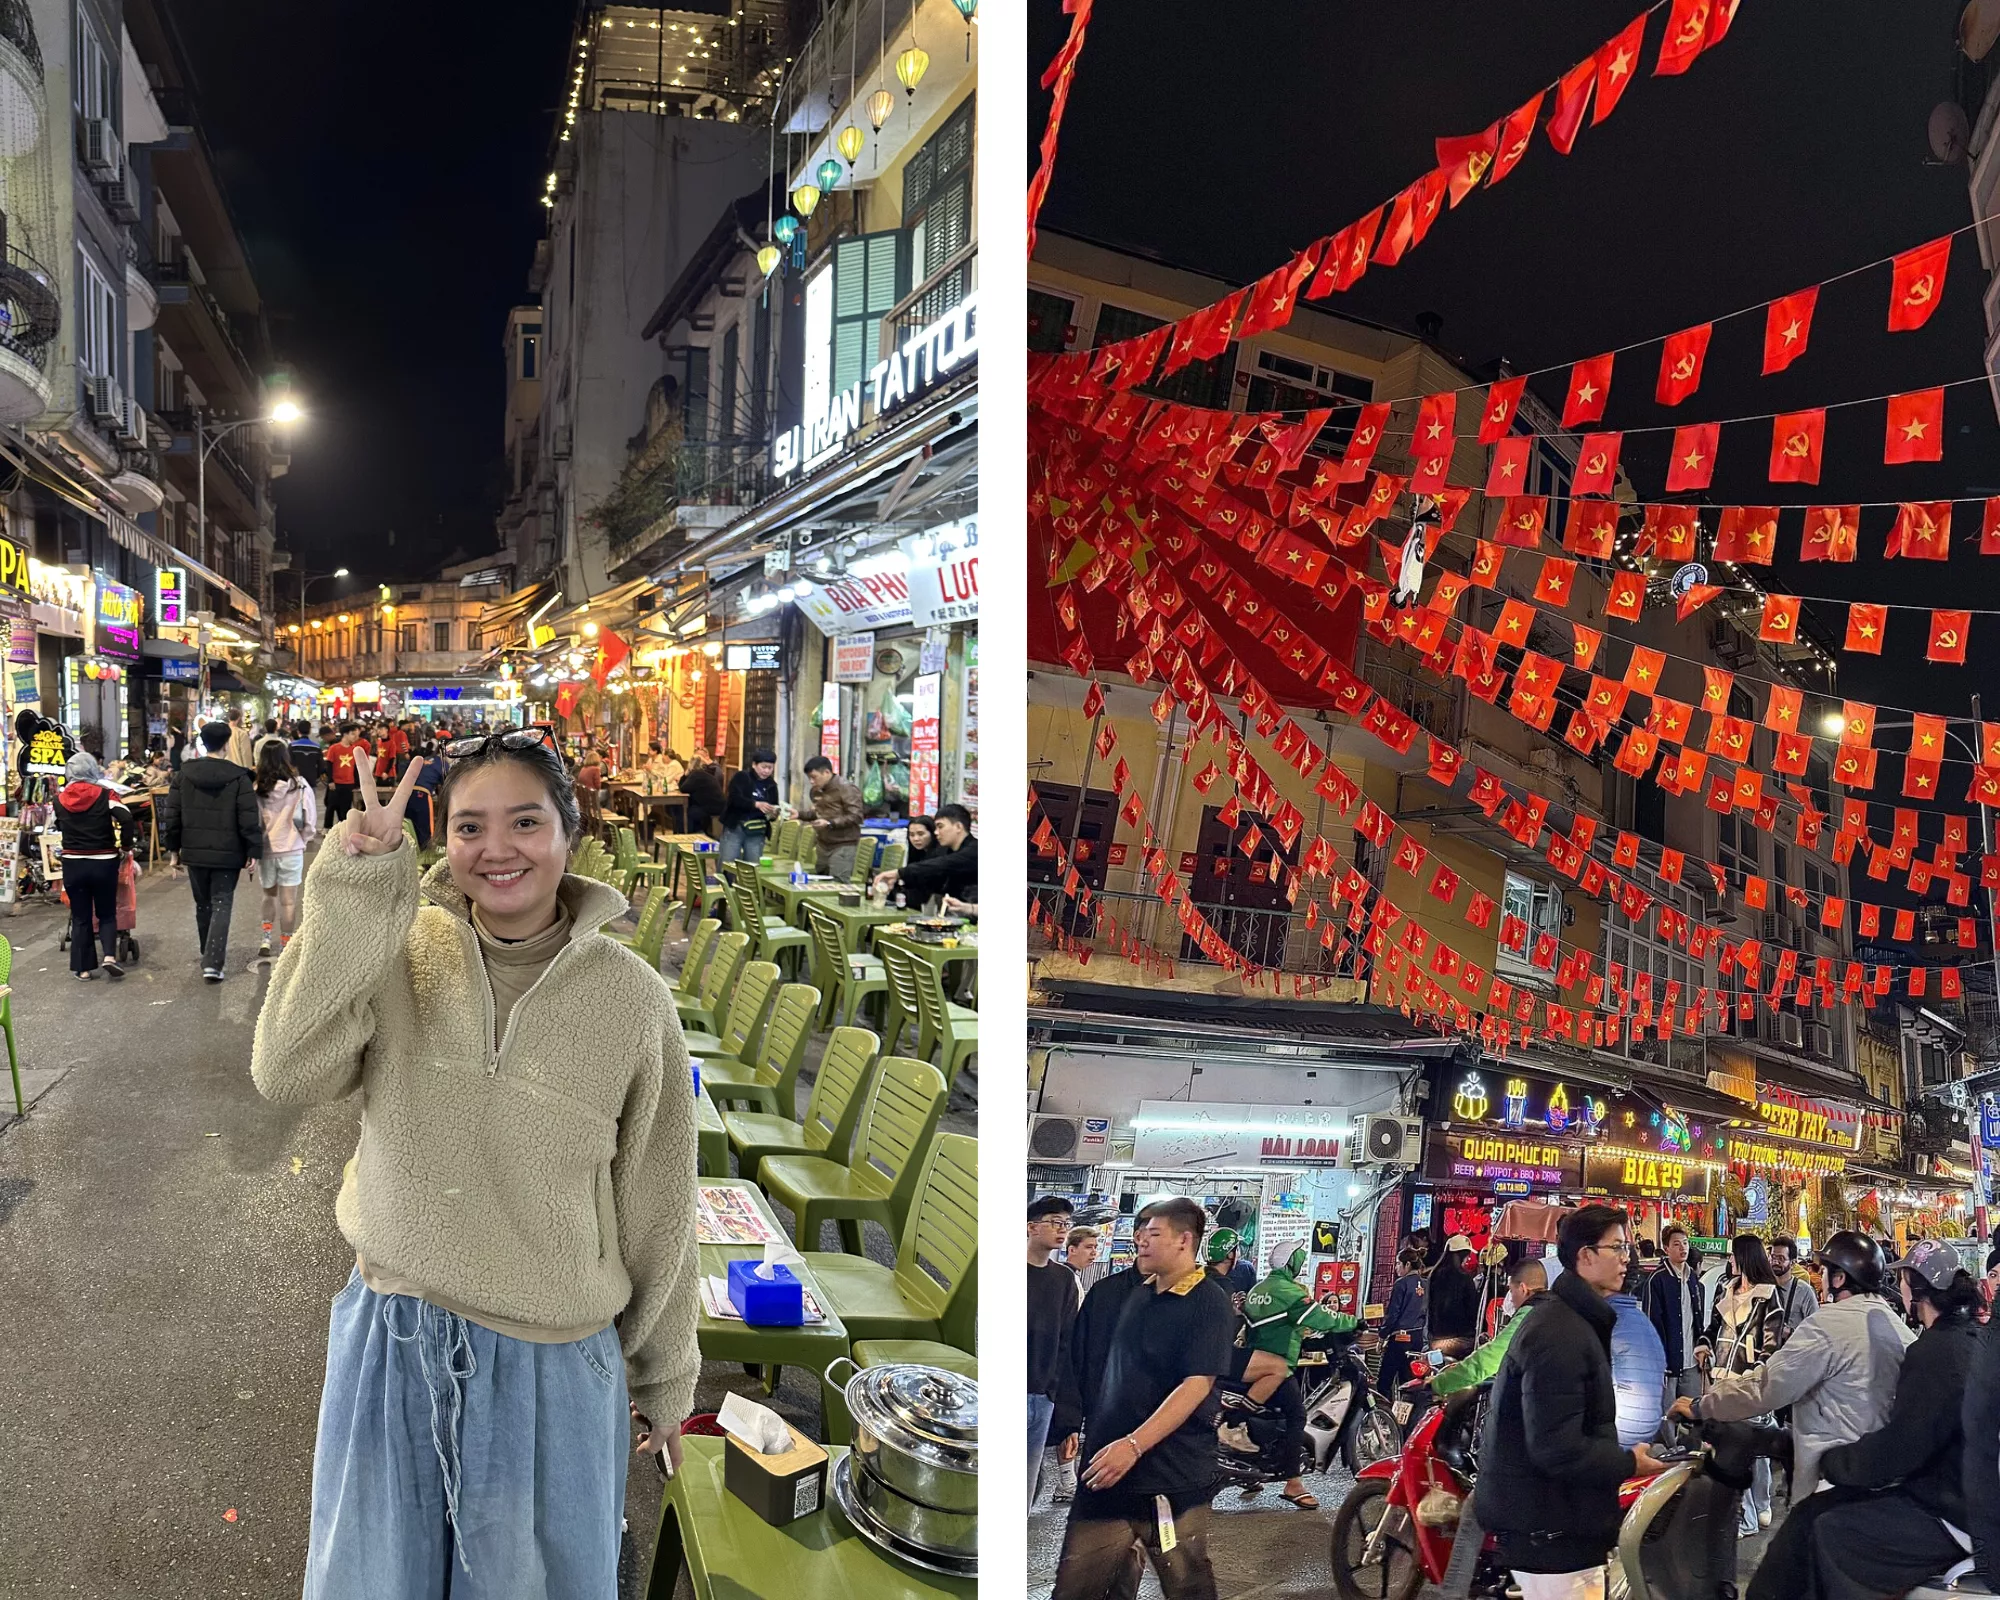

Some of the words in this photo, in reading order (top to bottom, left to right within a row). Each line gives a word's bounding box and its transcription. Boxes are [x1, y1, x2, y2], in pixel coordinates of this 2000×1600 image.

[774, 425, 799, 478] SU
[803, 381, 860, 461] TRAN
[30, 747, 66, 765] SPA
[1454, 1164, 1475, 1176] BEER
[1483, 1165, 1512, 1178] HOTPOT
[1624, 1157, 1658, 1186] BIA
[1661, 1161, 1683, 1189] 29
[1248, 1292, 1272, 1305] Grab
